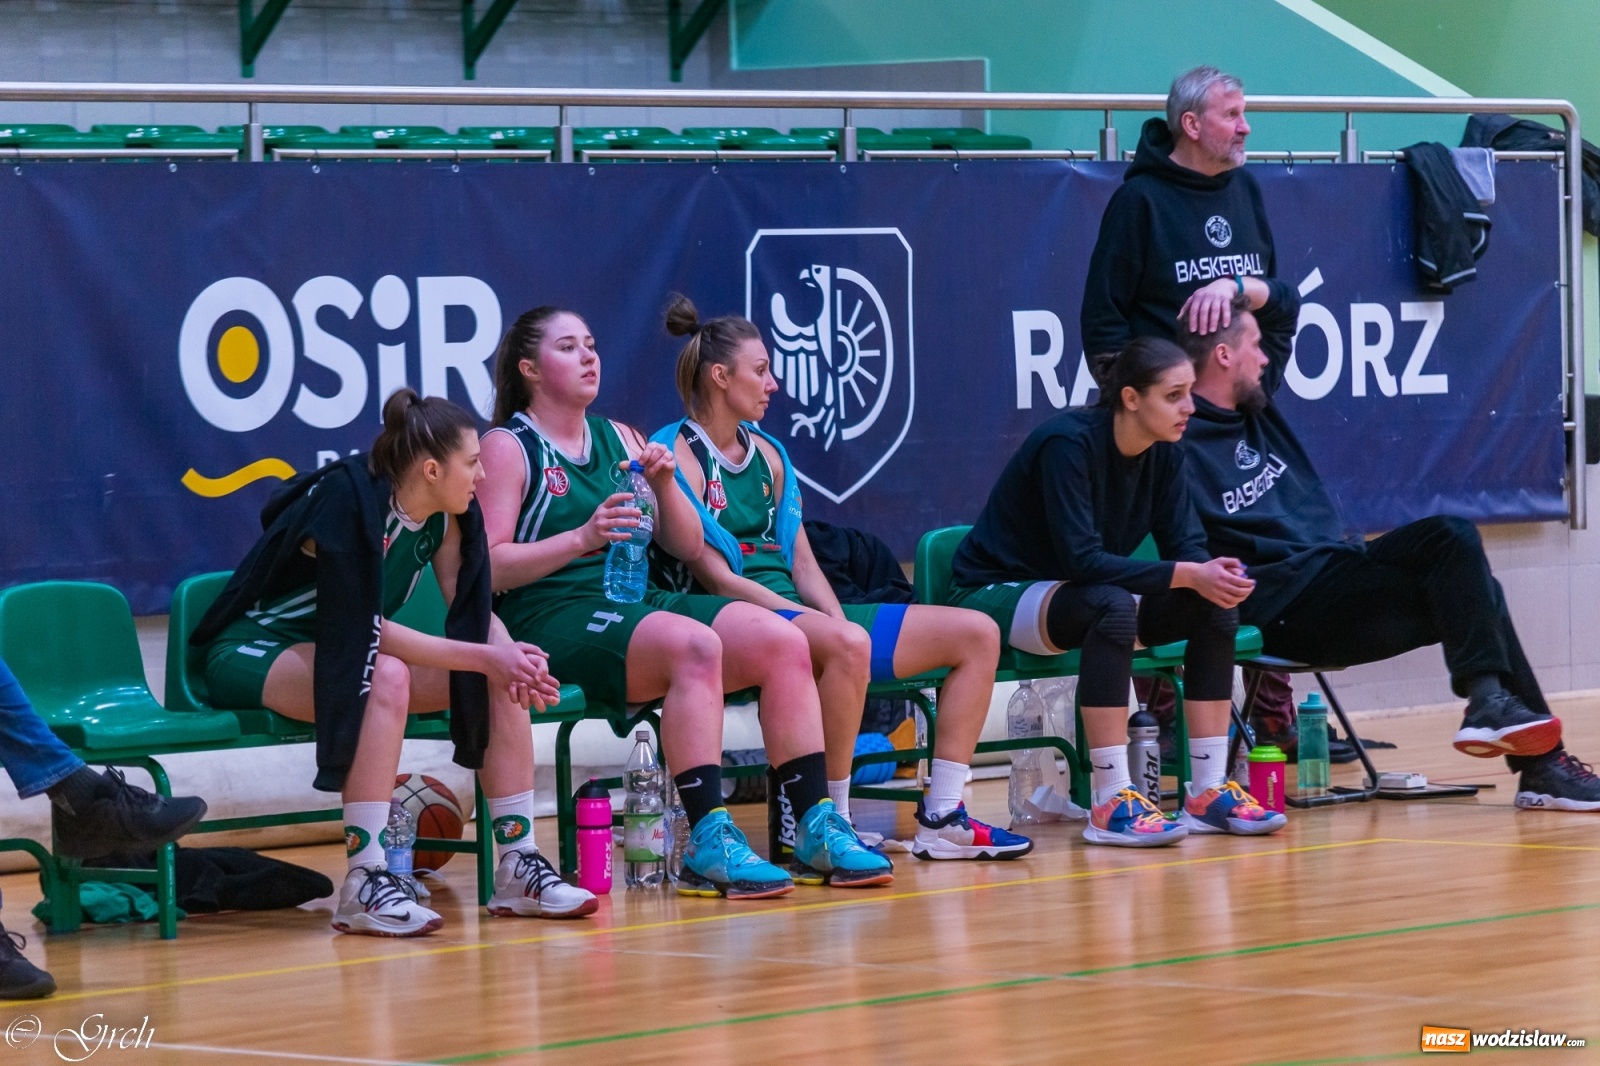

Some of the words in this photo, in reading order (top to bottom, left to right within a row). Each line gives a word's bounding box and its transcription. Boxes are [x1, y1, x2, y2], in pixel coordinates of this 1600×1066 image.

[1175, 253, 1264, 283] BASKETBALL
[178, 275, 502, 432] OSiR
[586, 611, 625, 633] 4
[1143, 750, 1160, 806] ostar
[777, 783, 797, 847] isost
[1519, 796, 1545, 807] FILA
[603, 842, 612, 879] Tacx
